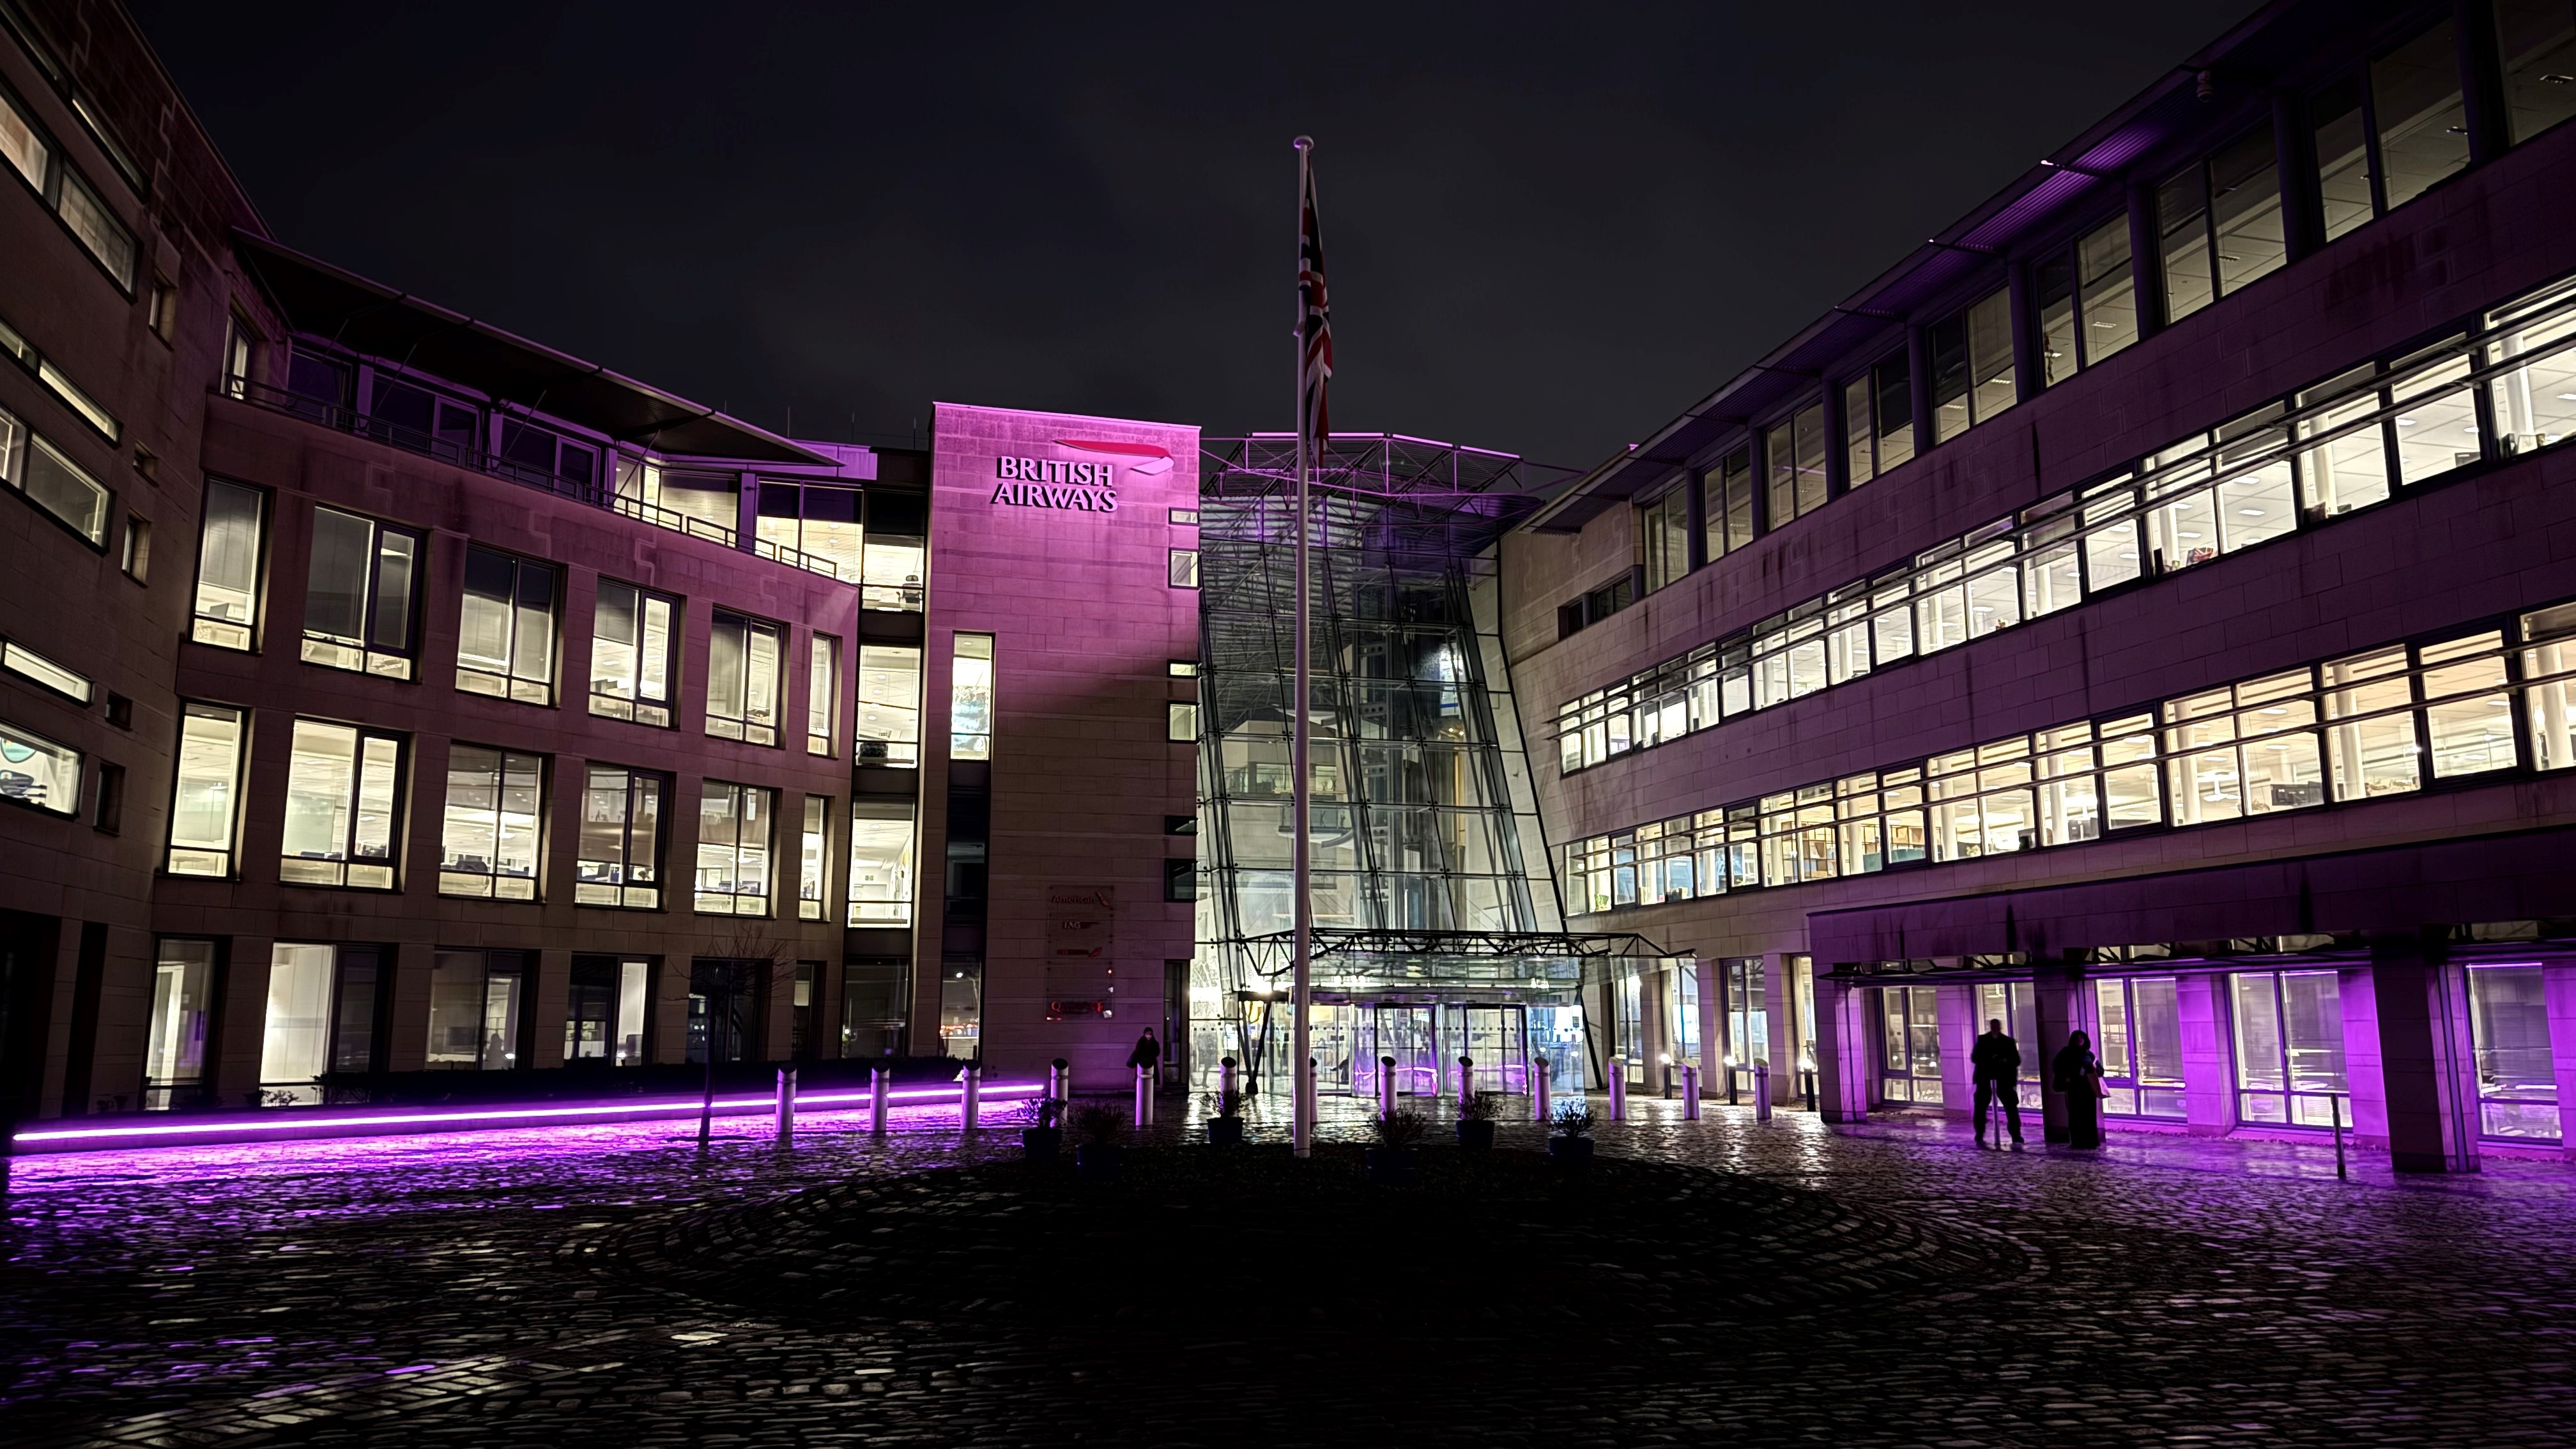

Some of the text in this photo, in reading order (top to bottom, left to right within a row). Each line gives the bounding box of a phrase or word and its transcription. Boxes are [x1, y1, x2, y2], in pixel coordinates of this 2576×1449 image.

[999, 456, 1113, 486] BRITISH
[994, 482, 1118, 512] AIRWAYS
[1052, 895, 1094, 904] American
[1063, 921, 1081, 930] IAG
